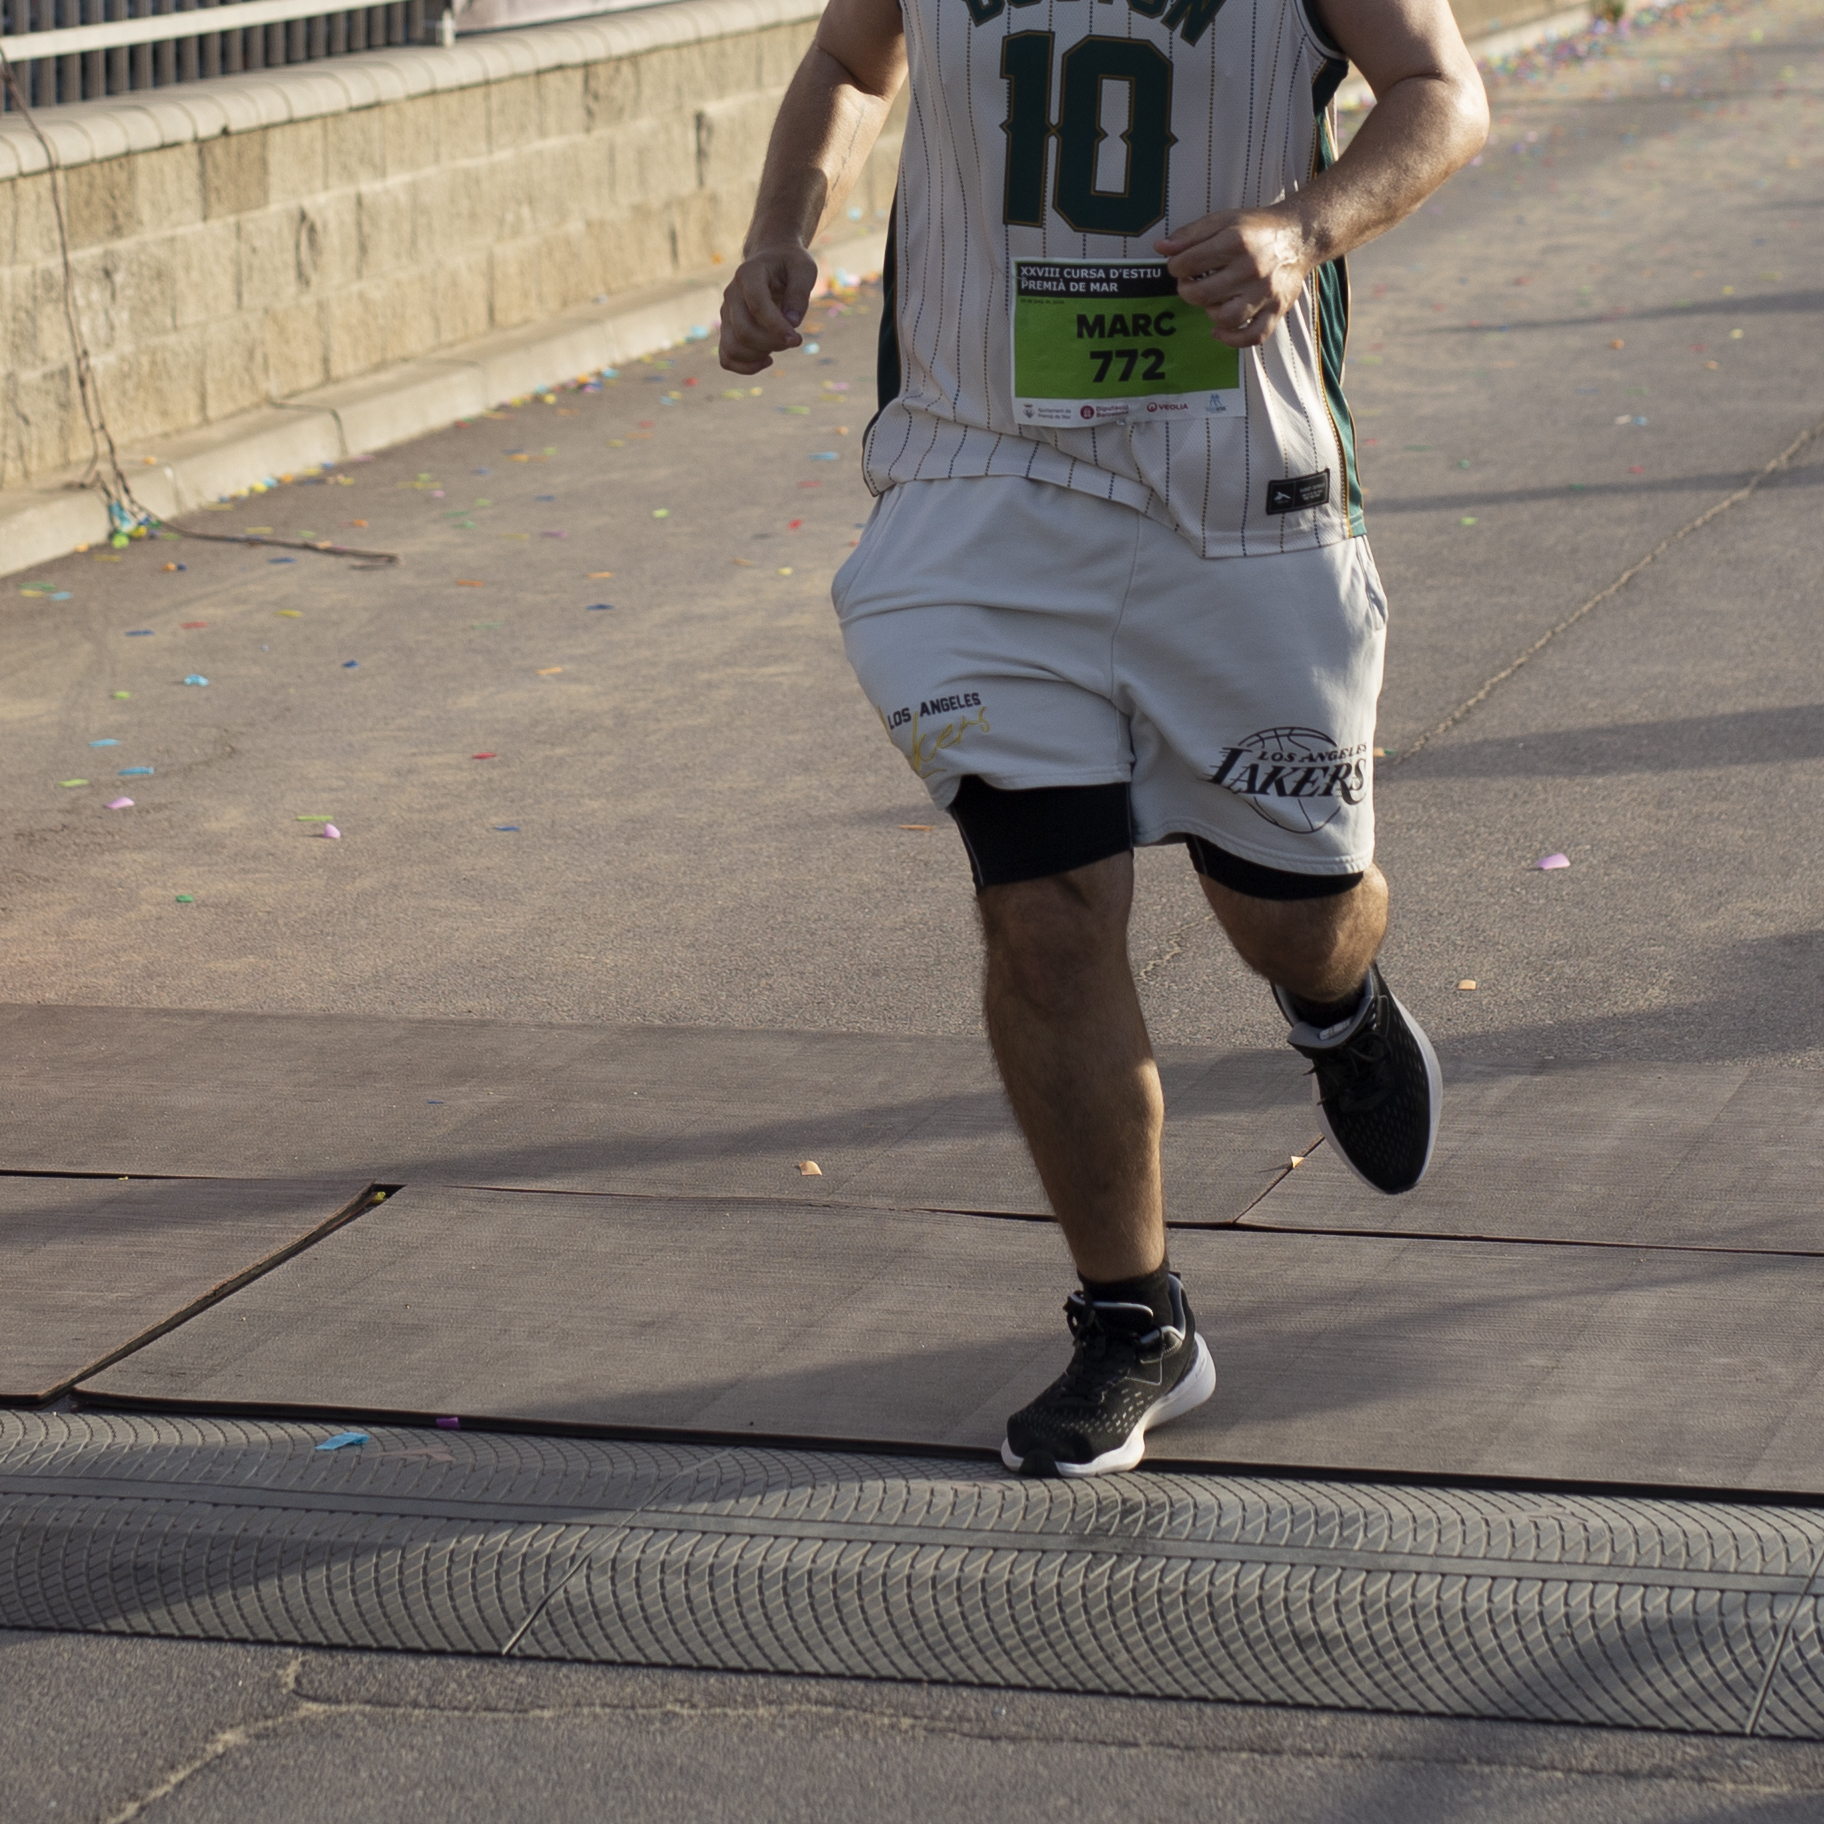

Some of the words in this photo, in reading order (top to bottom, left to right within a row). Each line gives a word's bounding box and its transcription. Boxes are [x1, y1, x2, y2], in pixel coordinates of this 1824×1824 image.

[1000, 29, 1178, 238] 10
[1020, 266, 1060, 278] XXVIII
[1063, 268, 1106, 279] CURSA
[1109, 268, 1162, 279] D'ESTIU
[1021, 279, 1066, 292] PREMIÀ
[1069, 282, 1087, 292] DE
[1090, 282, 1119, 292] MAR
[1076, 311, 1177, 339] MARC
[1090, 348, 1166, 383] 772
[887, 707, 912, 730] LOS
[919, 692, 982, 717] ANGELES
[1257, 751, 1298, 763] LOS
[1298, 742, 1367, 763] ANGELES
[1209, 746, 1367, 806] LAKERS
